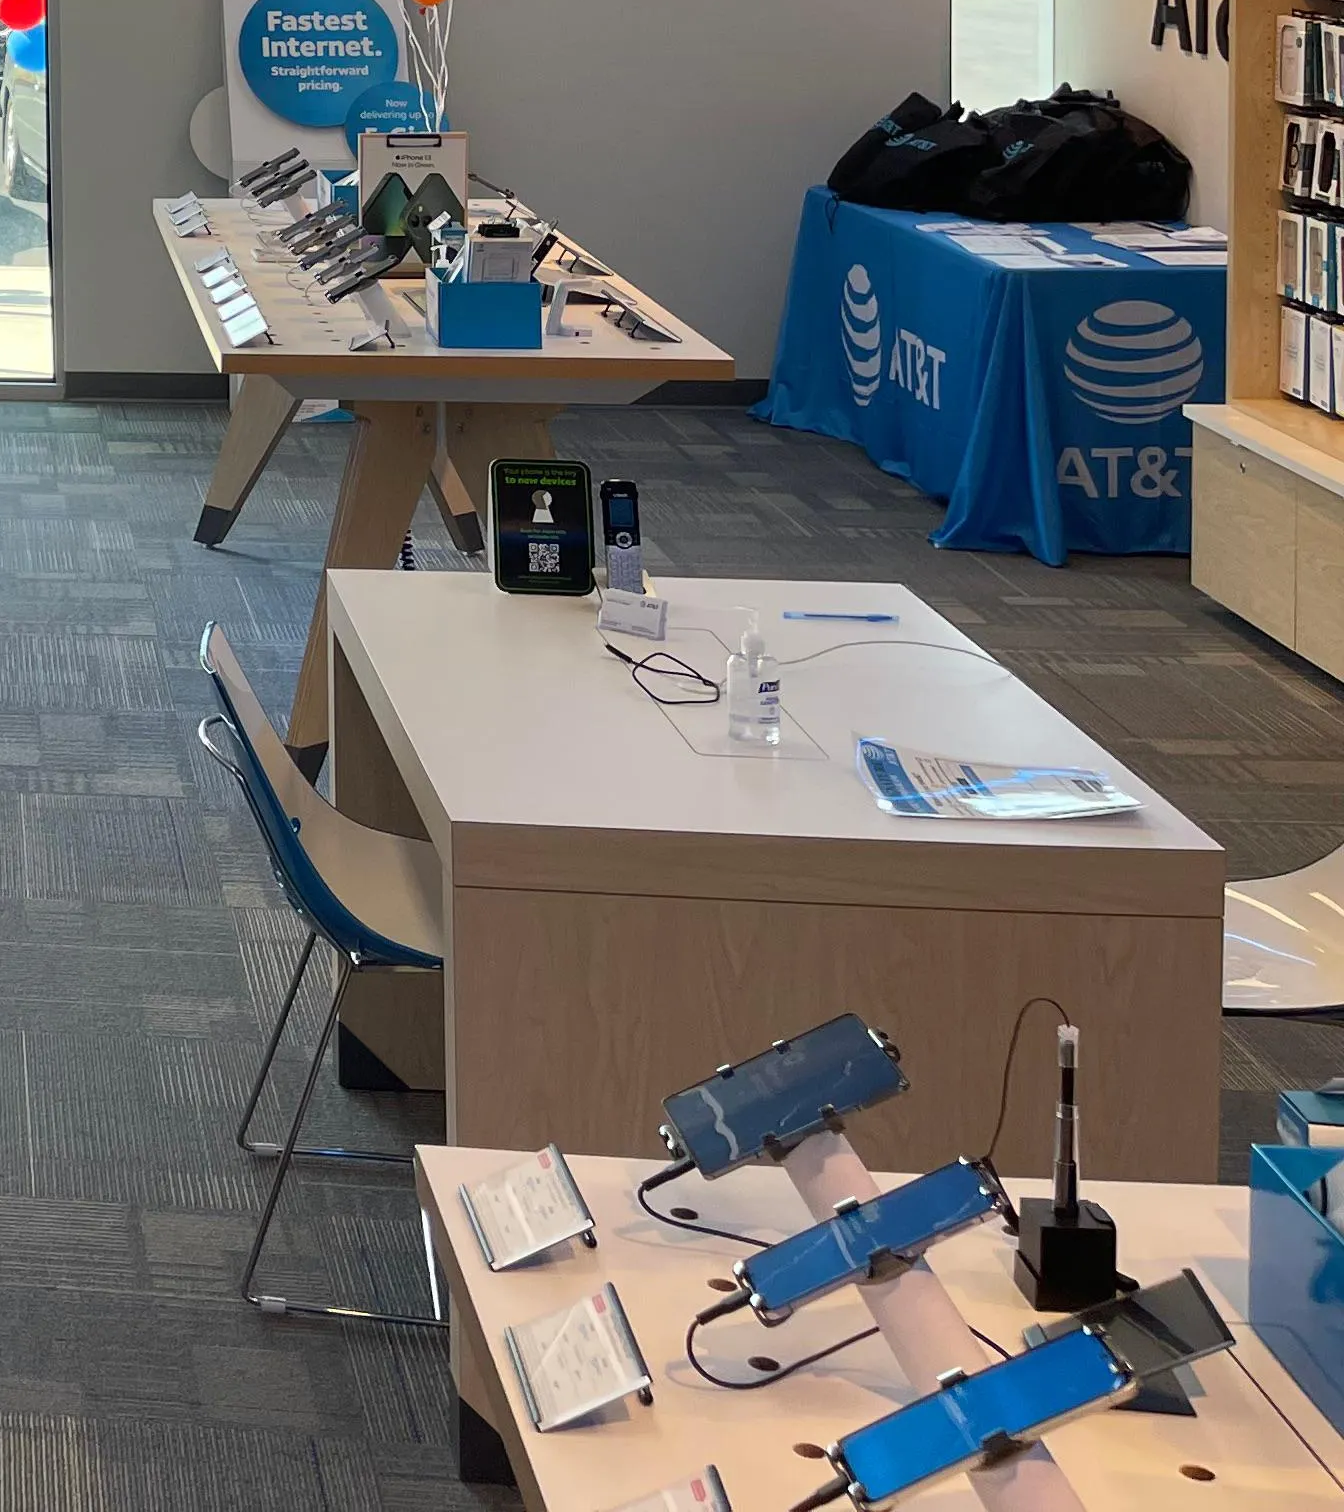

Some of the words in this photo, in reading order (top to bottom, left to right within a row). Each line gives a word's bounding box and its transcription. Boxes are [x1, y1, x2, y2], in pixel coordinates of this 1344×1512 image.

[266, 10, 368, 32] Fastest
[262, 37, 382, 58] Internet.
[271, 66, 369, 78] Straightforward
[298, 80, 343, 93] pricing.
[385, 99, 408, 107] Now
[359, 110, 408, 121] delivering
[409, 112, 422, 120] up
[888, 327, 947, 411] AT&T
[505, 476, 516, 484] to
[539, 477, 577, 486] devices
